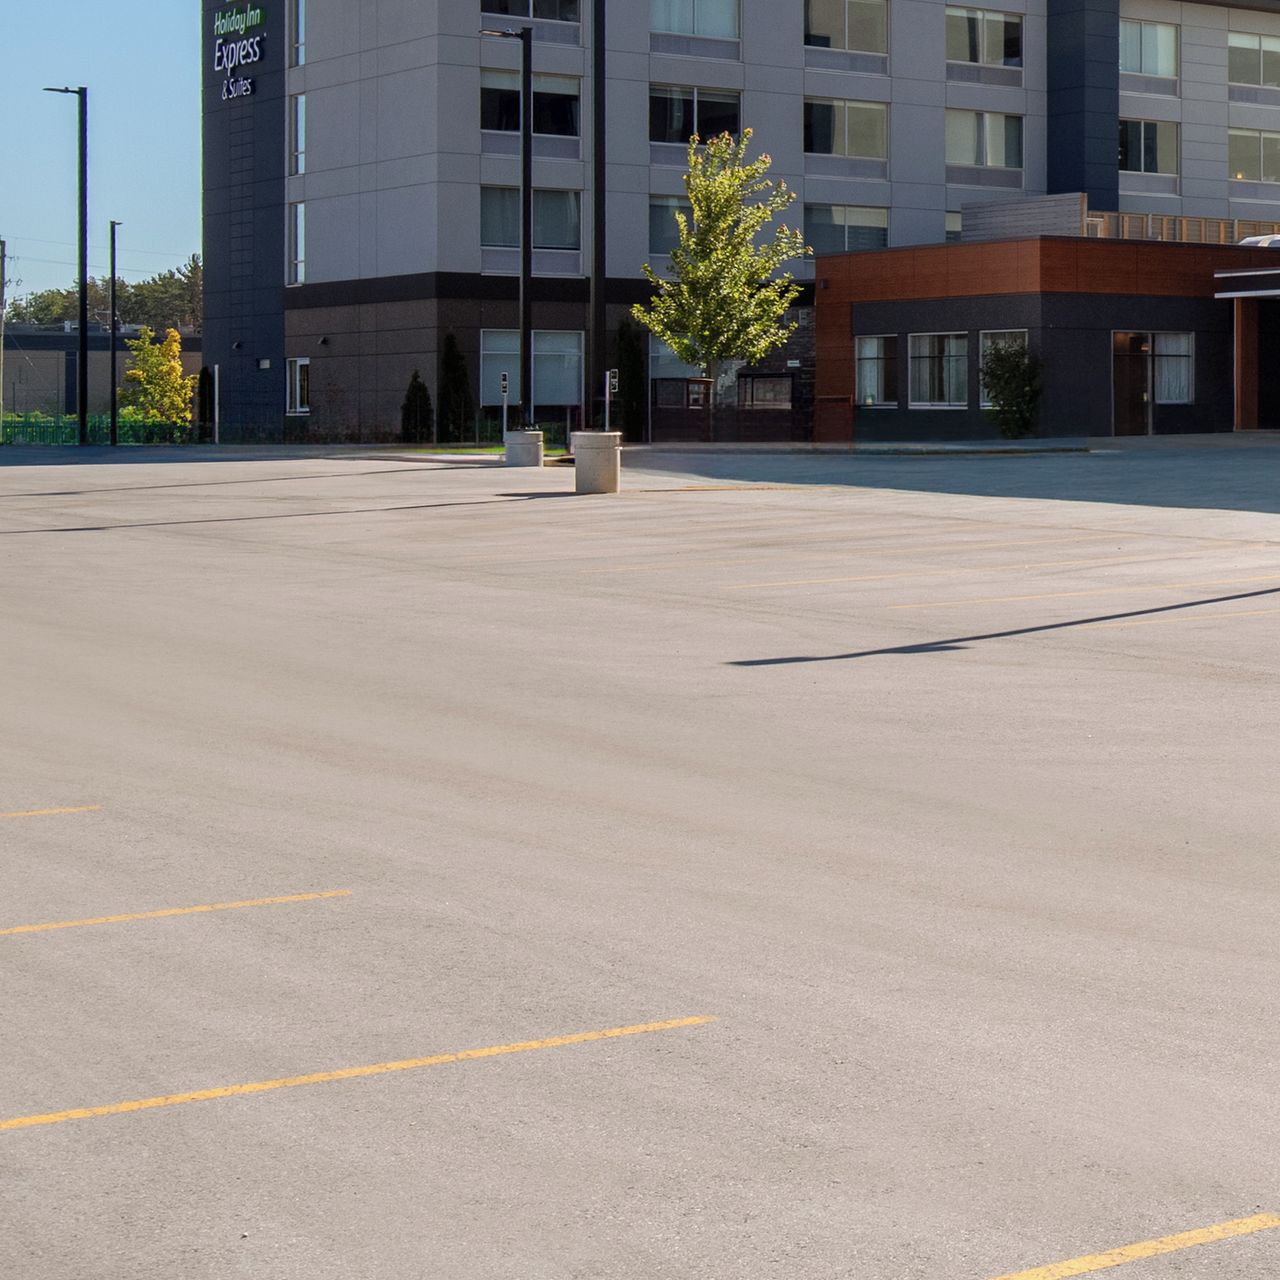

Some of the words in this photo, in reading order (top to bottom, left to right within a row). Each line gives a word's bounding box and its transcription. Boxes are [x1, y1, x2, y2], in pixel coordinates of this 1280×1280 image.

[214, 7, 247, 36] Holiday
[246, 4, 260, 26] Inn
[214, 35, 260, 77] Express
[221, 80, 228, 101] &
[228, 78, 251, 99] Suites
